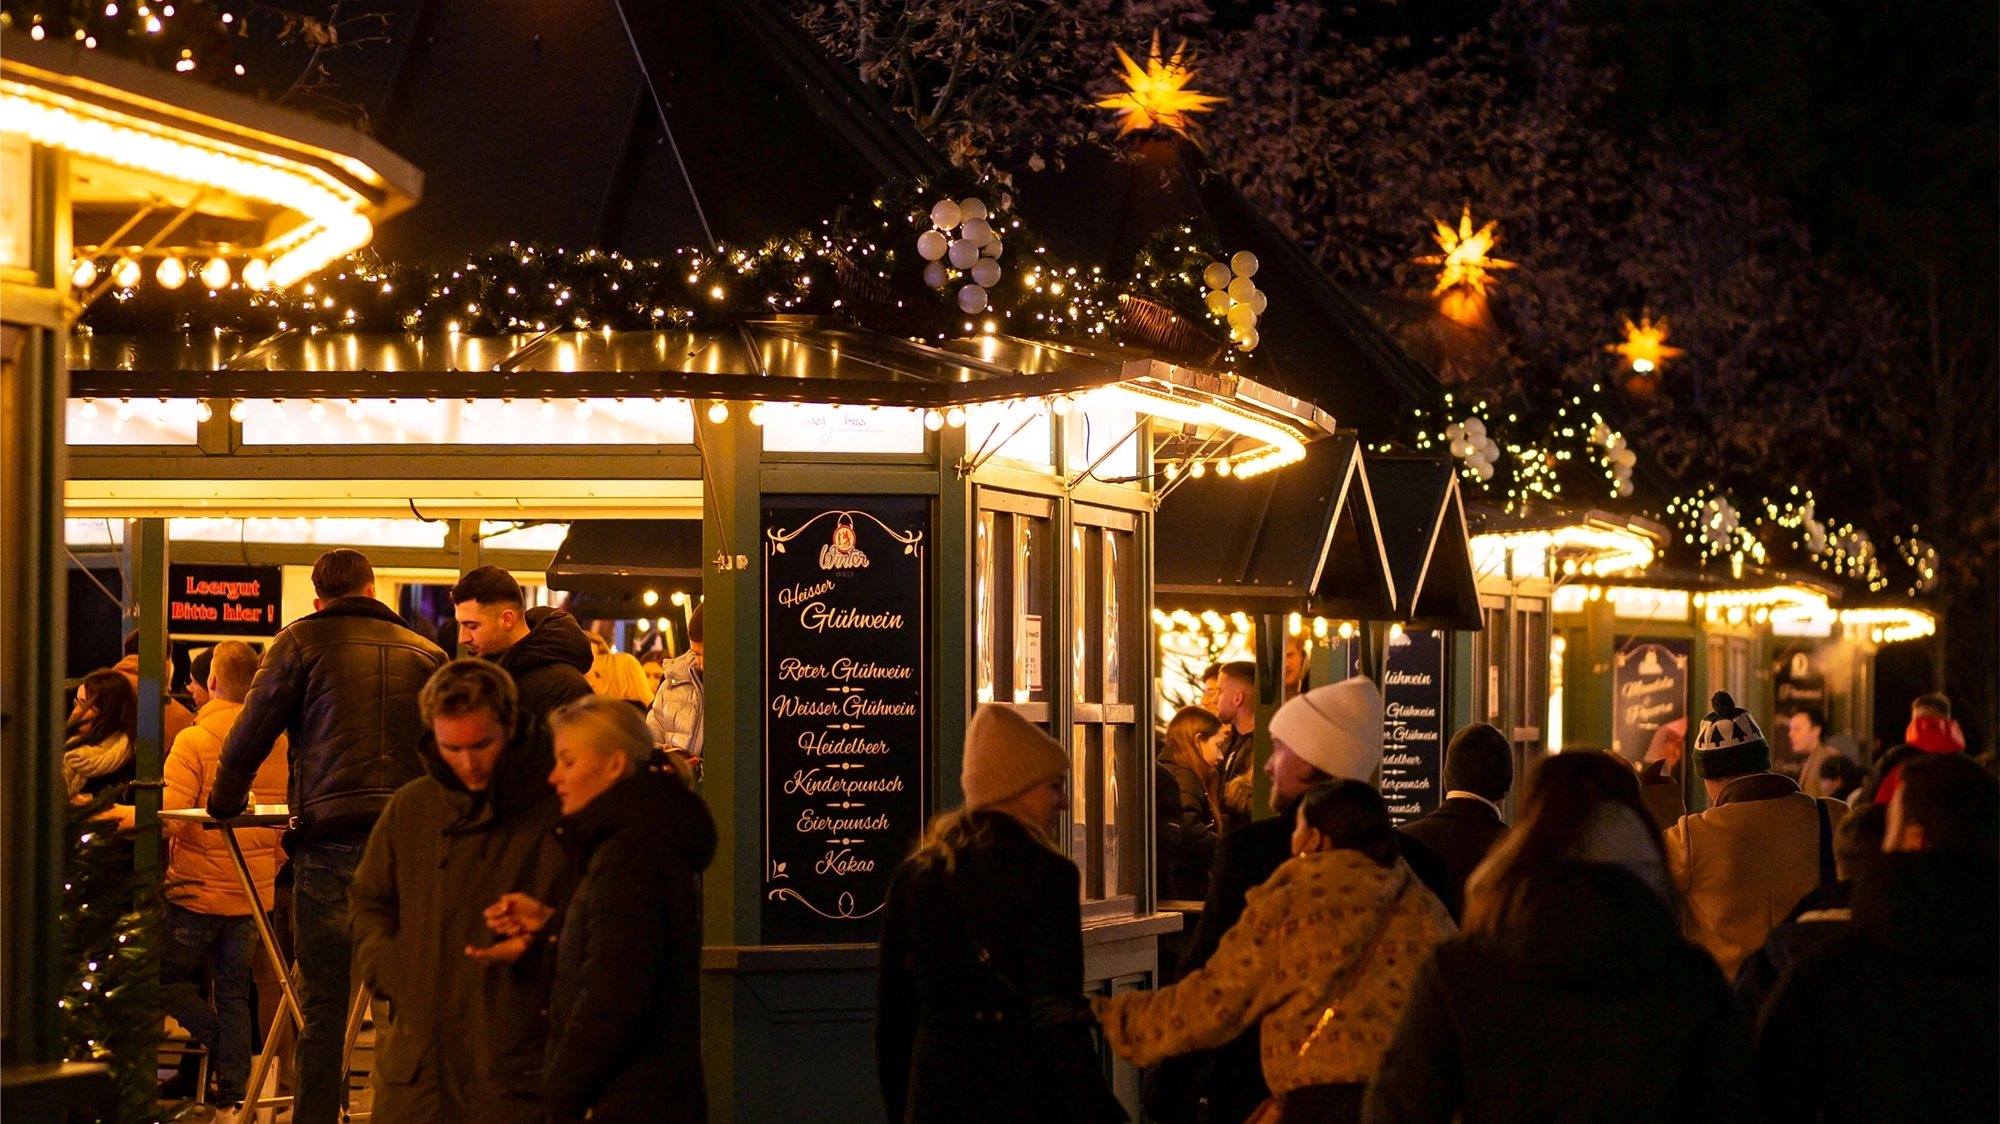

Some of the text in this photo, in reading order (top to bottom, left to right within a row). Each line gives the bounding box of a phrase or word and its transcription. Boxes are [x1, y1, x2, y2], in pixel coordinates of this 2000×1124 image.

[819, 542, 869, 570] Winter
[186, 576, 260, 600] Leergut
[778, 580, 835, 608] Heisser
[172, 602, 274, 622] Bitte hier !
[800, 600, 904, 633] Glühwein
[779, 658, 911, 682] Roter Glühwein
[1385, 670, 1432, 685] lühwein
[772, 695, 915, 719] Weisser Glühwein
[1386, 702, 1436, 718] Glühwein
[798, 731, 889, 755] Heidelbeer
[1393, 726, 1438, 742] Glühwein
[1383, 754, 1422, 765] idelbeer
[784, 767, 903, 796] Kinderpunsch
[797, 809, 889, 834] Eierpunsch
[816, 849, 874, 875] Kakao
